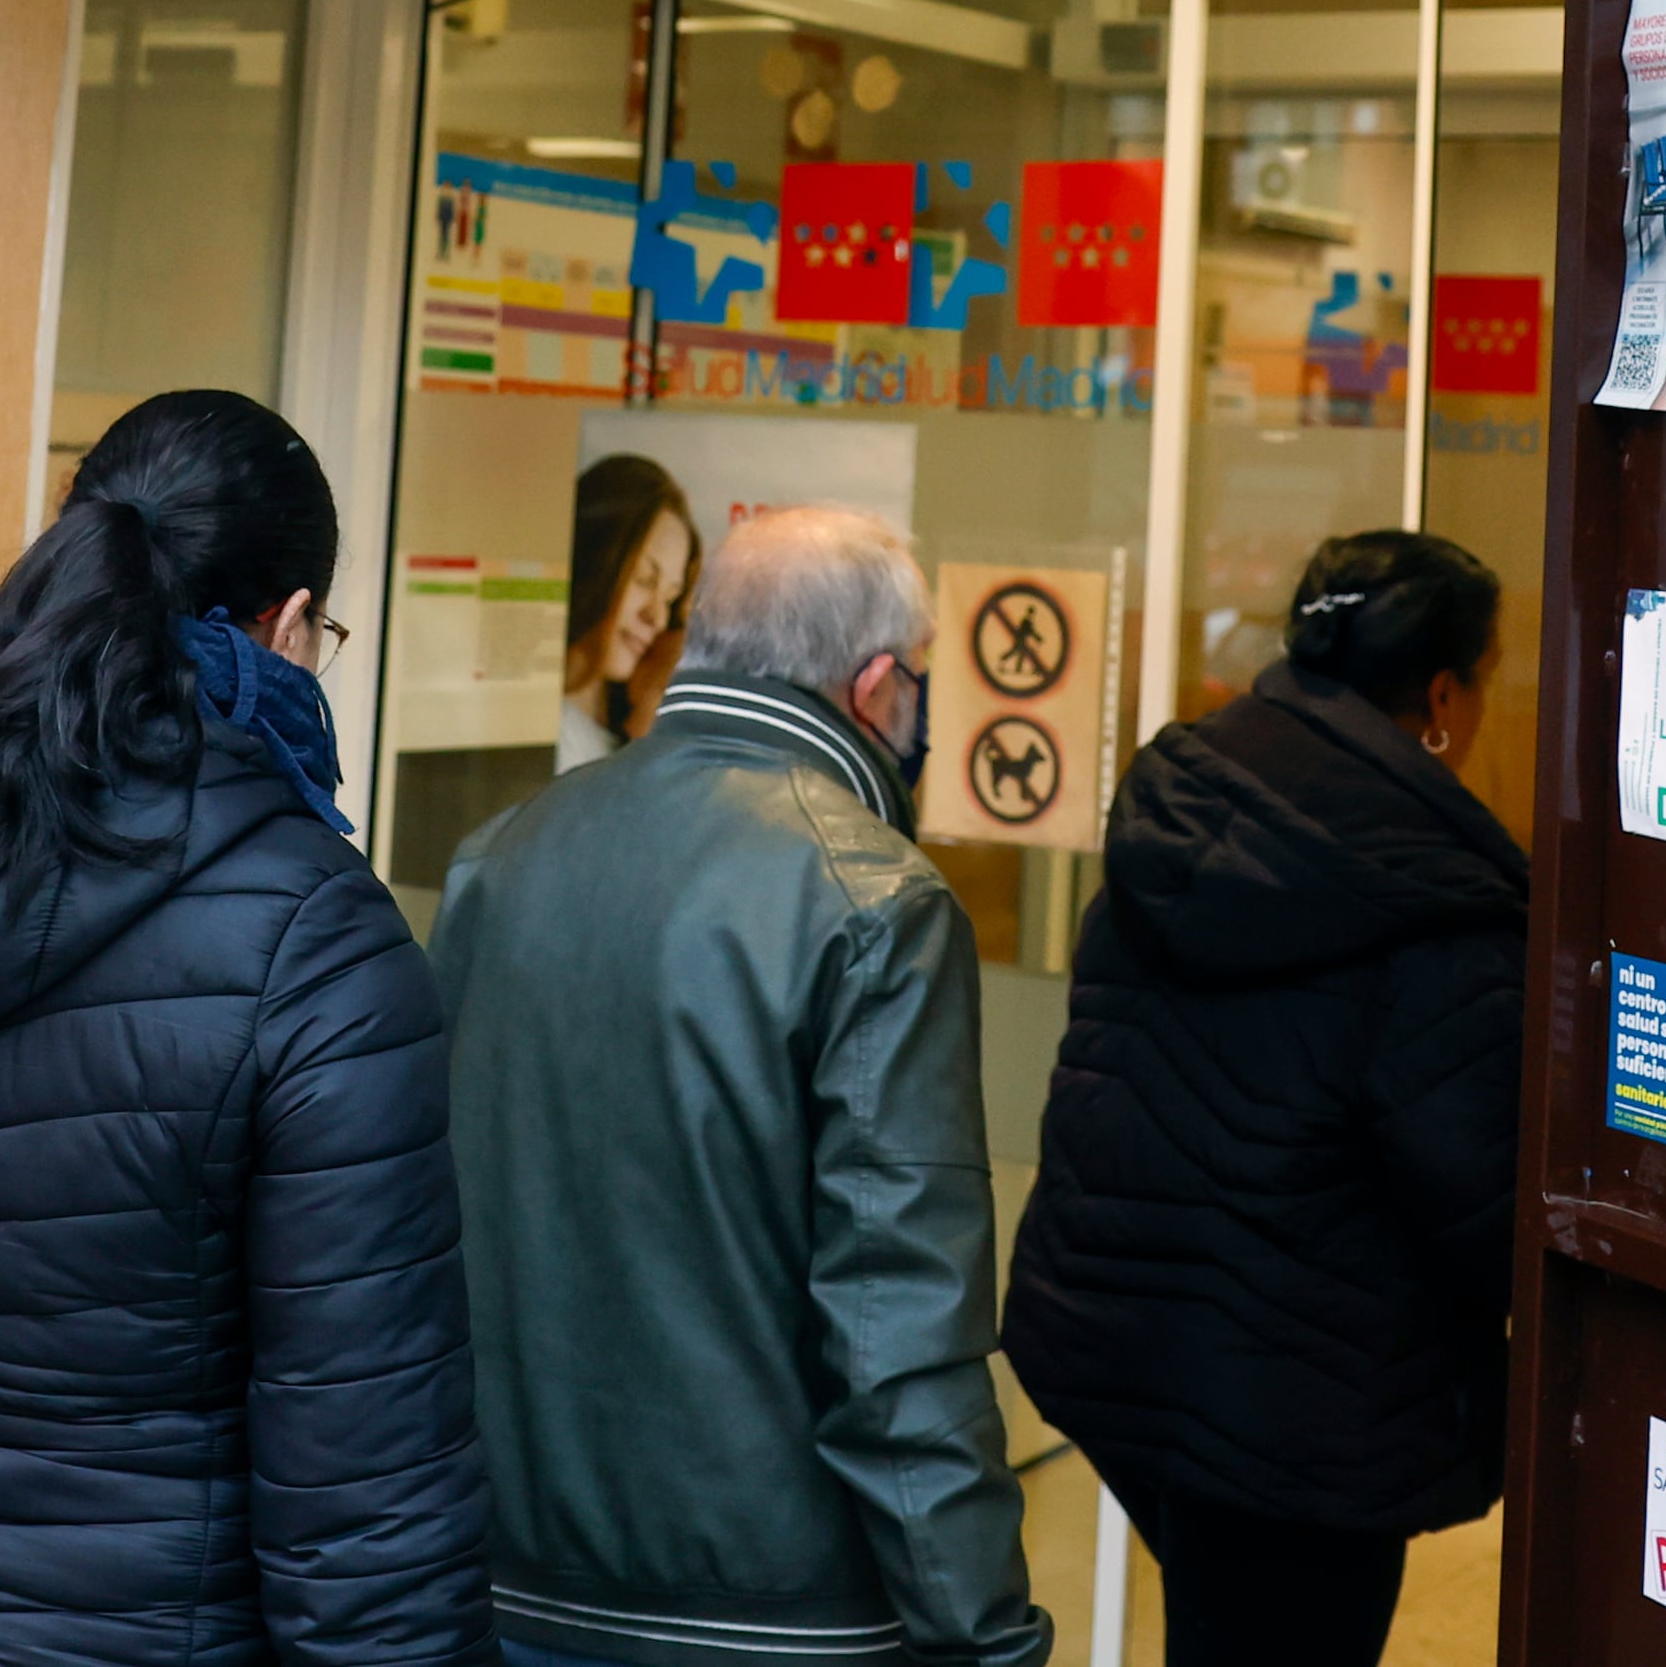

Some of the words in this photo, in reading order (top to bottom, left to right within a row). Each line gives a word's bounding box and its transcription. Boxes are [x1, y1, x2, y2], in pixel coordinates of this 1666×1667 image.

[1619, 964, 1635, 985] ni
[1635, 971, 1656, 990] un
[1618, 989, 1666, 1015] centro
[1618, 1011, 1659, 1036] salud
